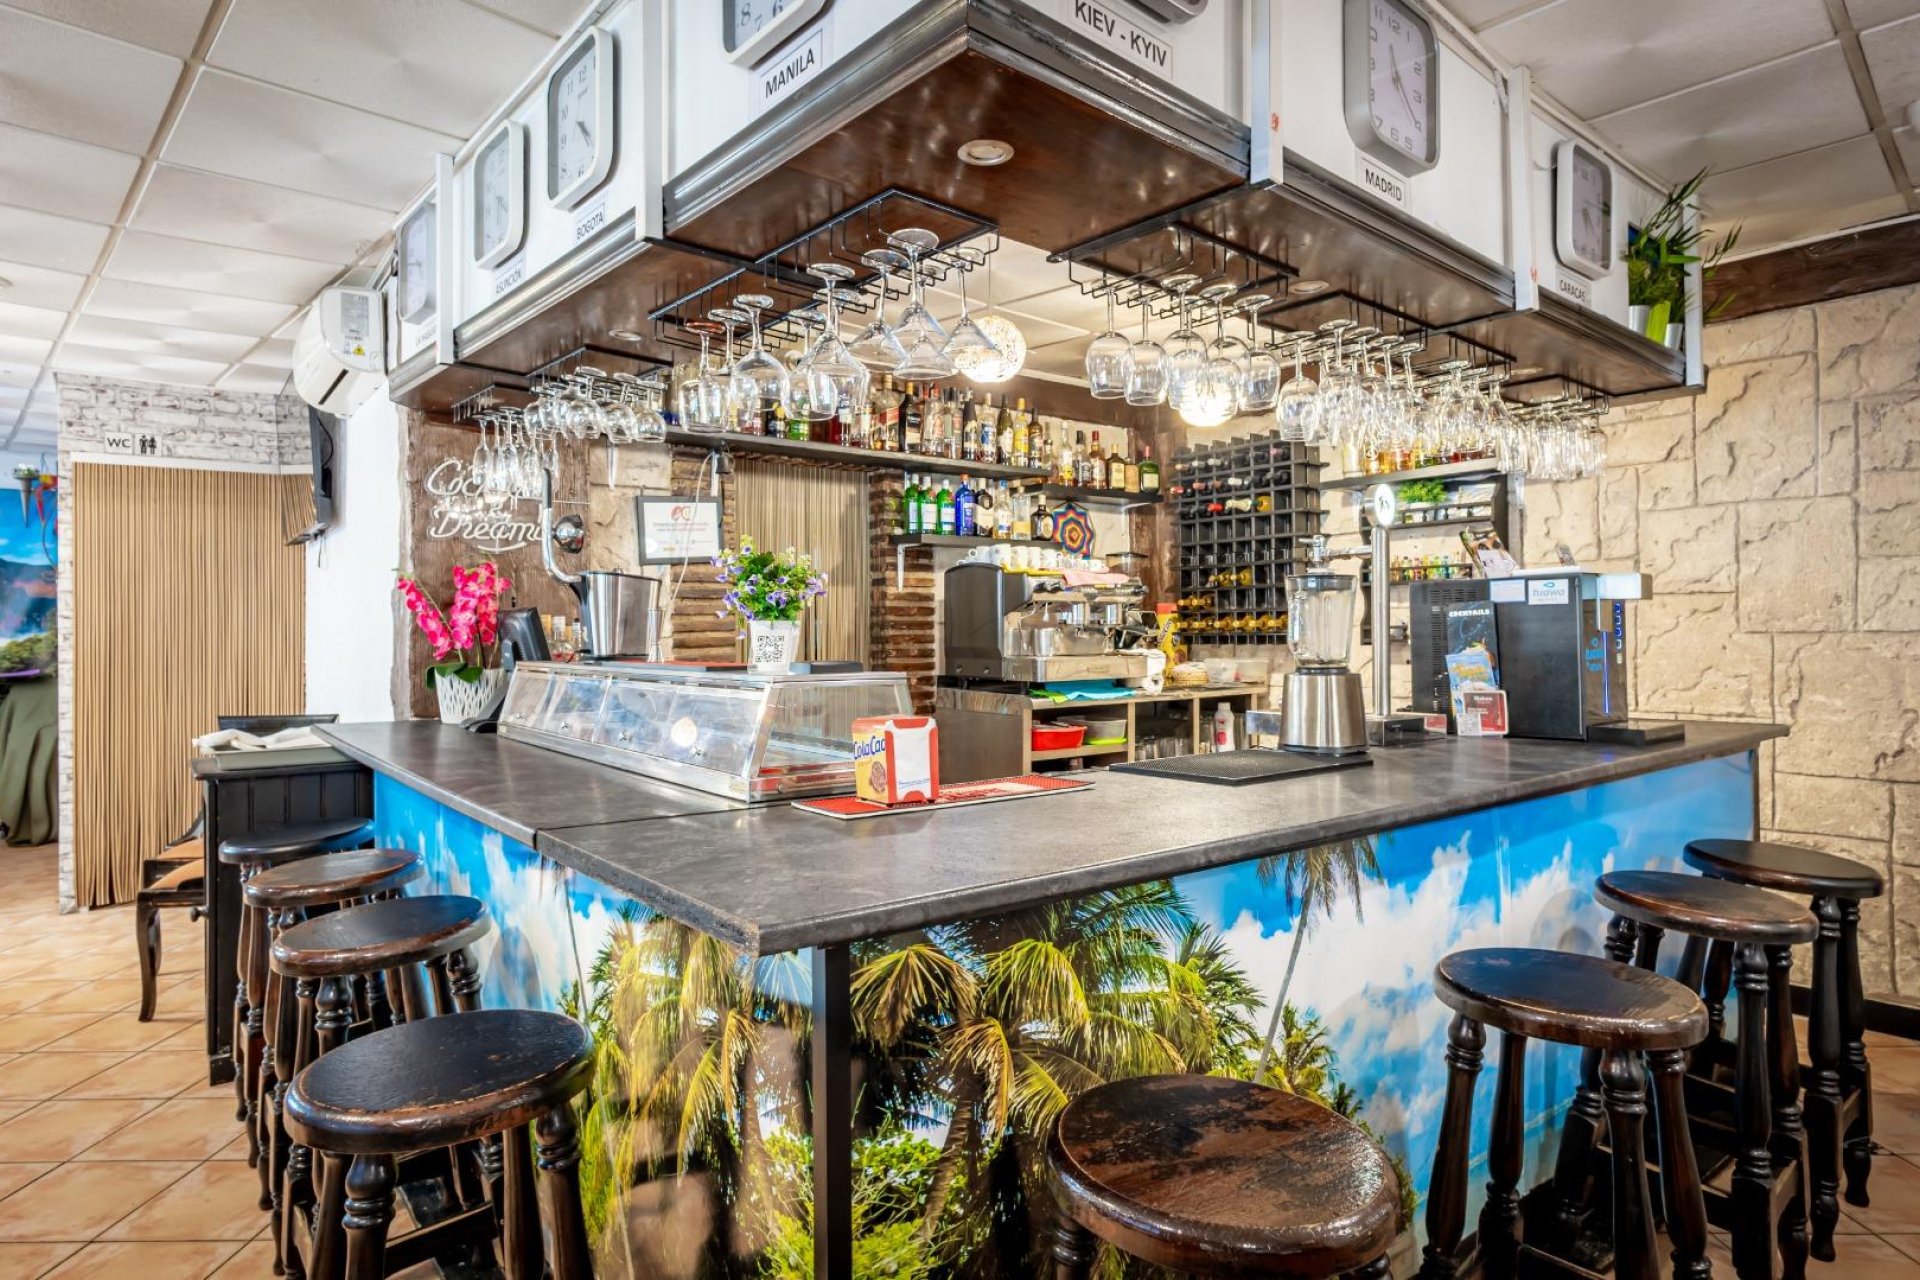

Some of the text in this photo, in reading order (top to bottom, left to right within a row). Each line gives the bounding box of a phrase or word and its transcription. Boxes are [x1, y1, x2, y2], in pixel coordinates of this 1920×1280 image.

[1075, 0, 1116, 37] KIEV
[1130, 30, 1167, 67] KYIV
[1388, 15, 1400, 34] 12
[765, 48, 815, 99] MANILA
[1365, 169, 1402, 201] MADRID
[576, 211, 603, 240] BOGOTA
[1560, 279, 1585, 301] CARACAS
[107, 437, 131, 448] WC
